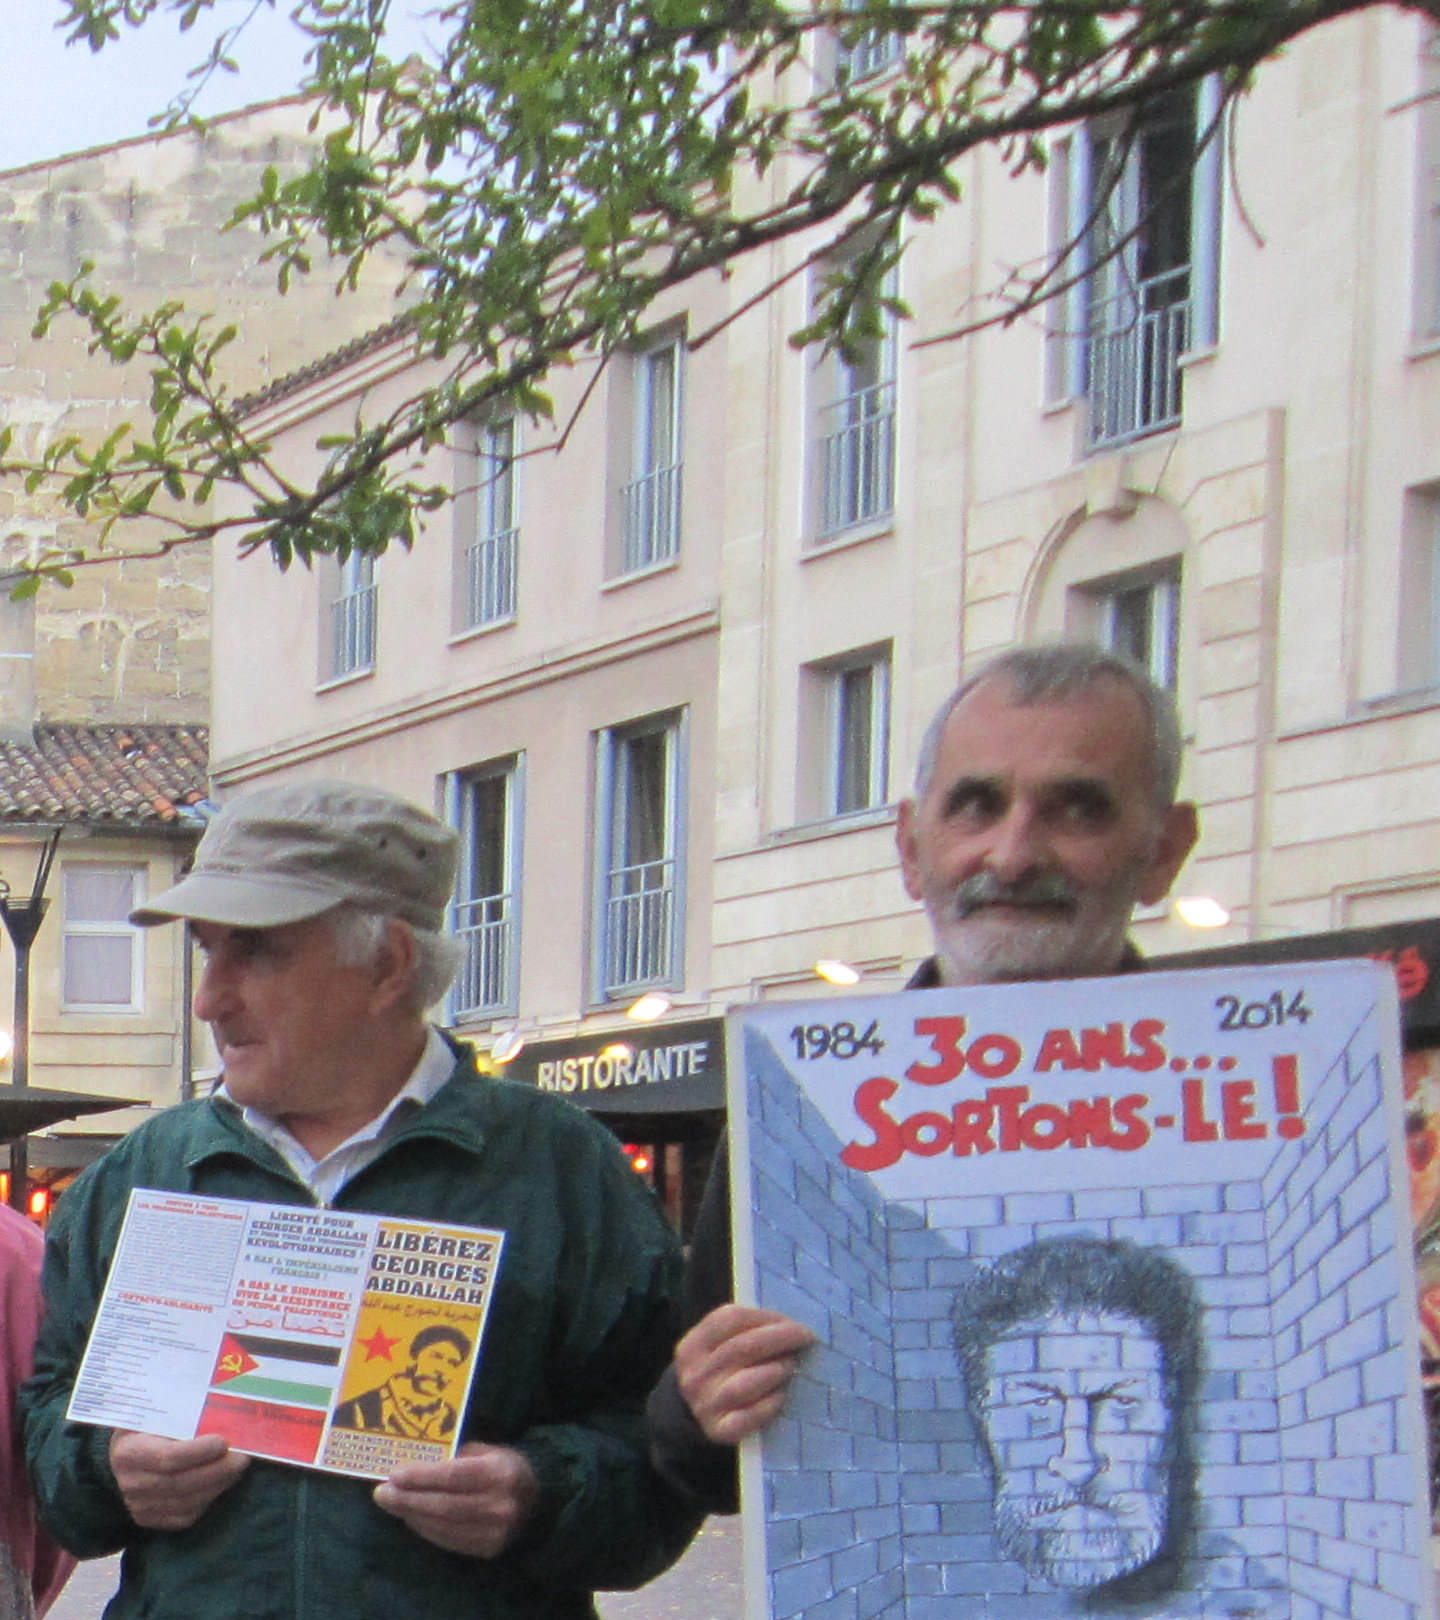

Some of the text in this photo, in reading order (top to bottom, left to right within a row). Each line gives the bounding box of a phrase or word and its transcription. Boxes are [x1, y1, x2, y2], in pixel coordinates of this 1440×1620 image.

[1216, 989, 1312, 1033] 2014
[789, 1022, 885, 1060] 1984
[904, 1016, 1236, 1085] 30 ANS...
[537, 1041, 711, 1092] RISTORANTE
[252, 1220, 368, 1241] GEORGES ABDALLAH
[376, 1229, 495, 1262] LIBÉREZ
[370, 1253, 490, 1286] GEORGES
[236, 1289, 261, 1300] VIVE
[366, 1275, 484, 1305] ABDALLAH
